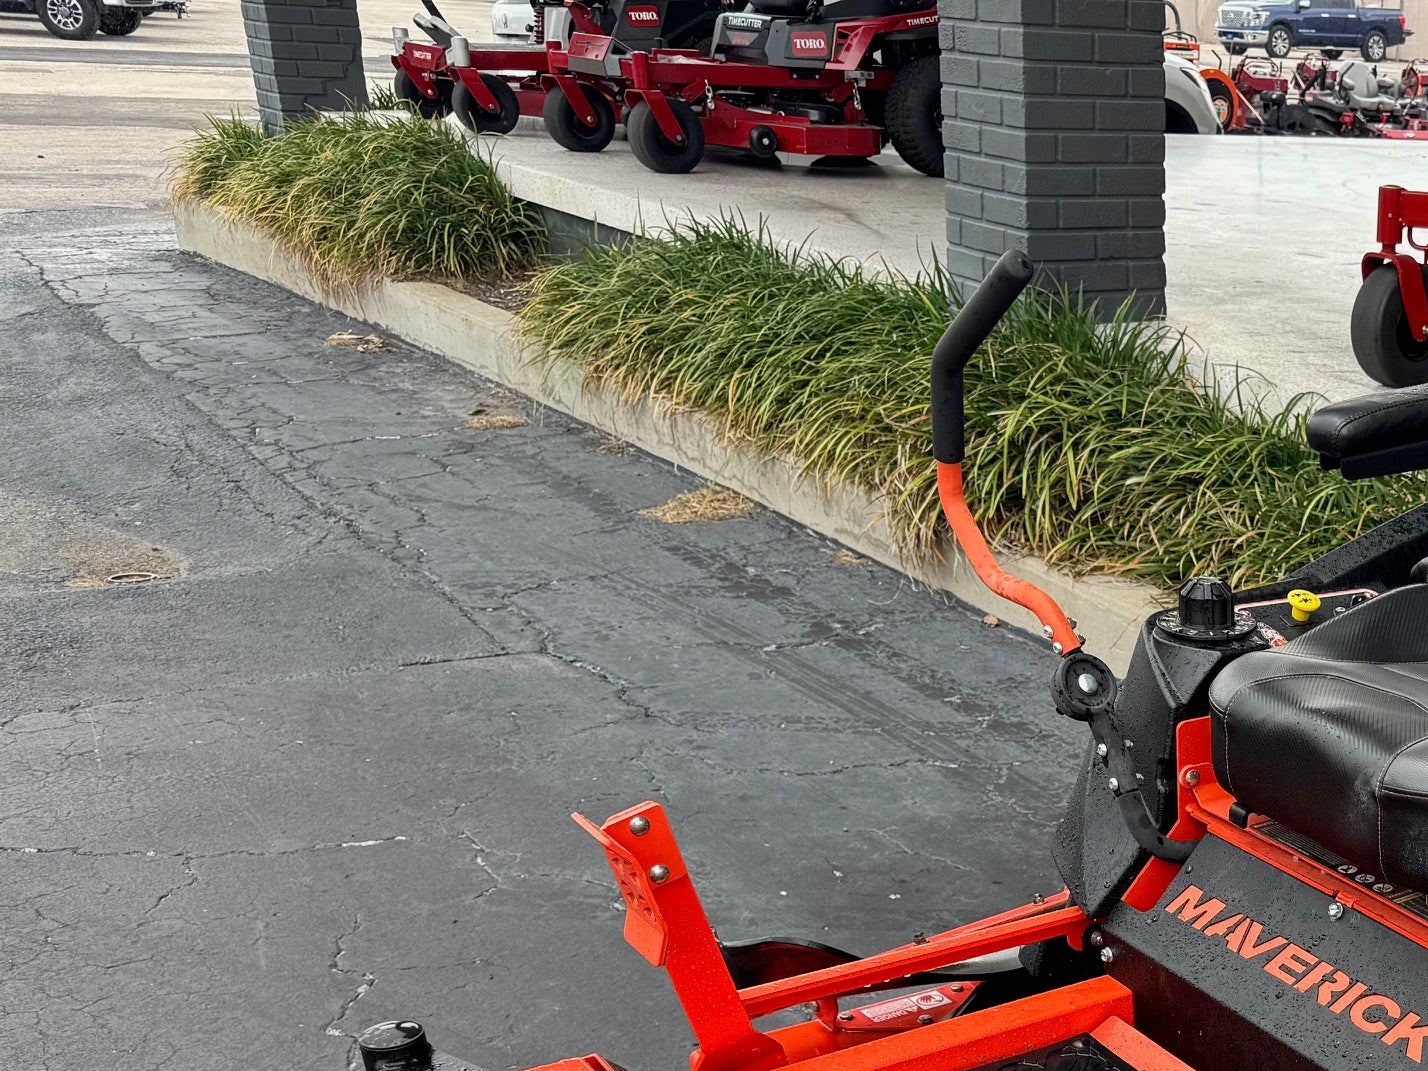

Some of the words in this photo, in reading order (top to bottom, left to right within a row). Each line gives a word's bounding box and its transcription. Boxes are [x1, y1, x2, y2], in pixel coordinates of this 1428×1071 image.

[628, 11, 659, 21] TORO
[728, 16, 763, 29] TIMECUTTER
[793, 38, 826, 49] TORO
